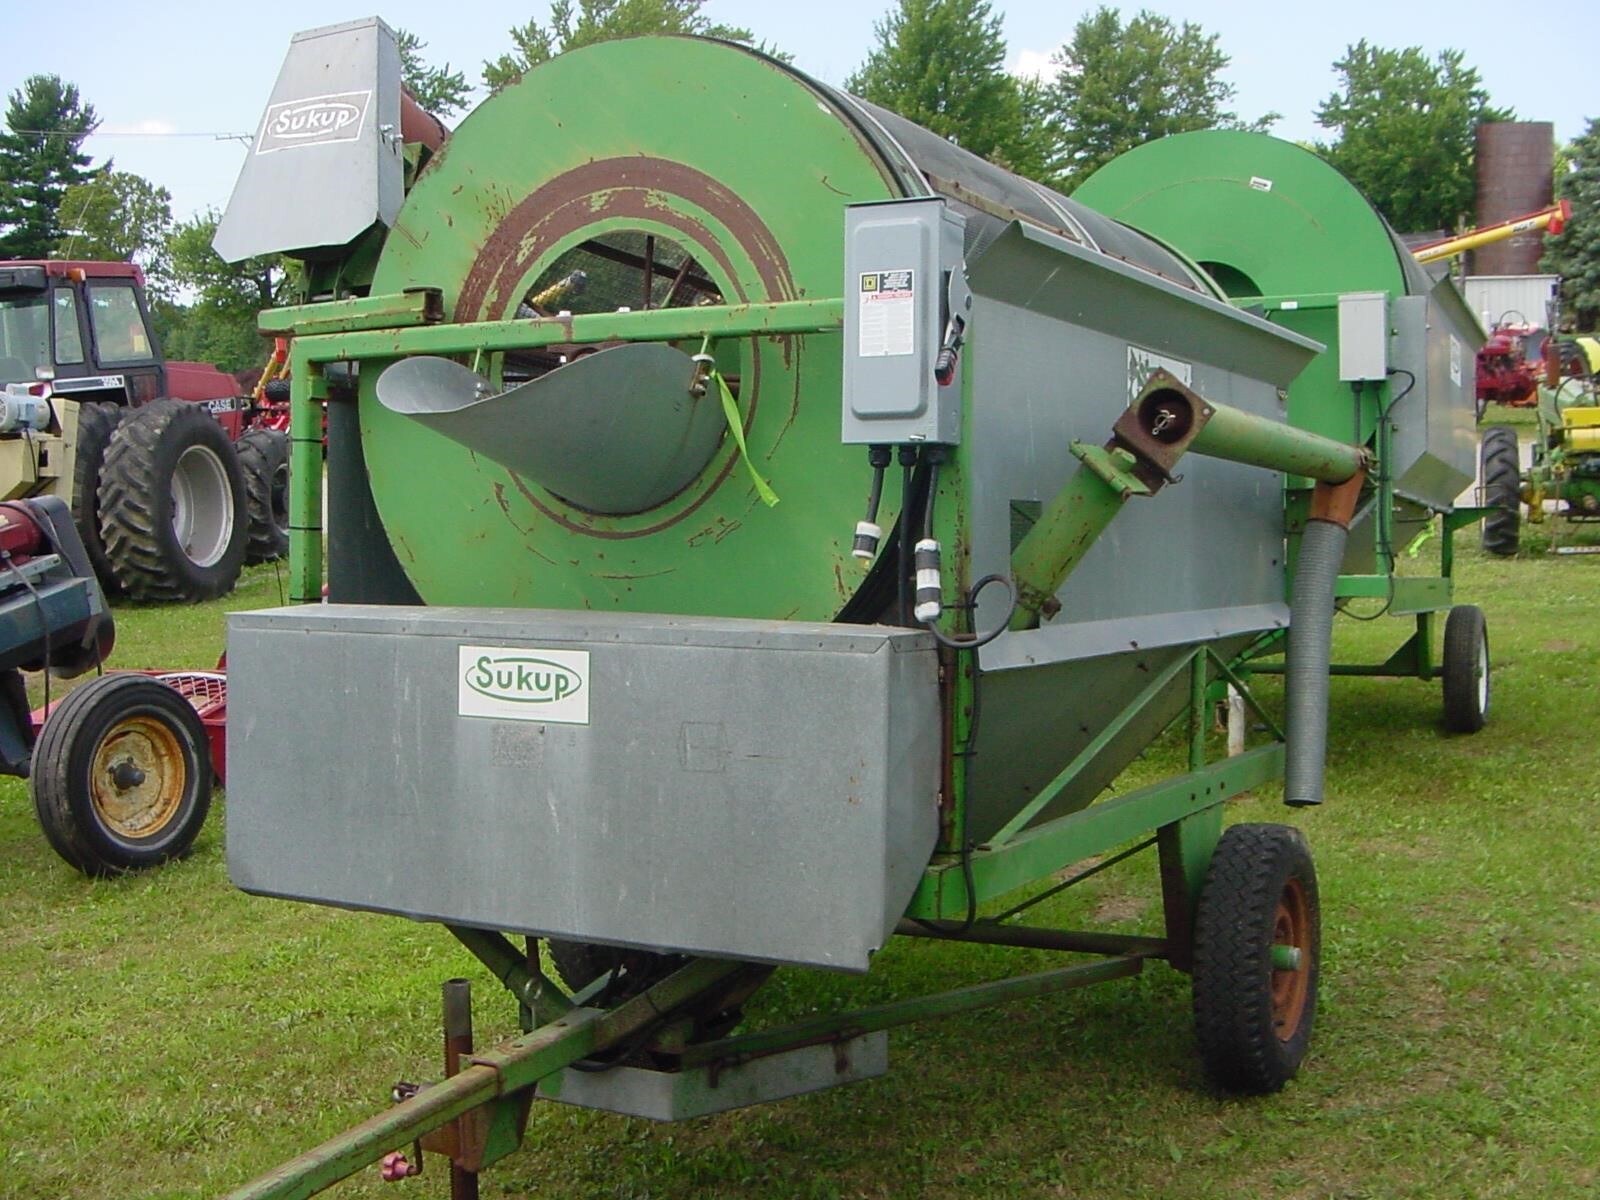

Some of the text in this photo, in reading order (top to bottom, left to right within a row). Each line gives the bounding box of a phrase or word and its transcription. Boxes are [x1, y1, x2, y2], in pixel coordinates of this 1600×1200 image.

[275, 108, 351, 133] Sukup
[207, 399, 232, 411] CASE
[475, 655, 570, 702] Sukup
